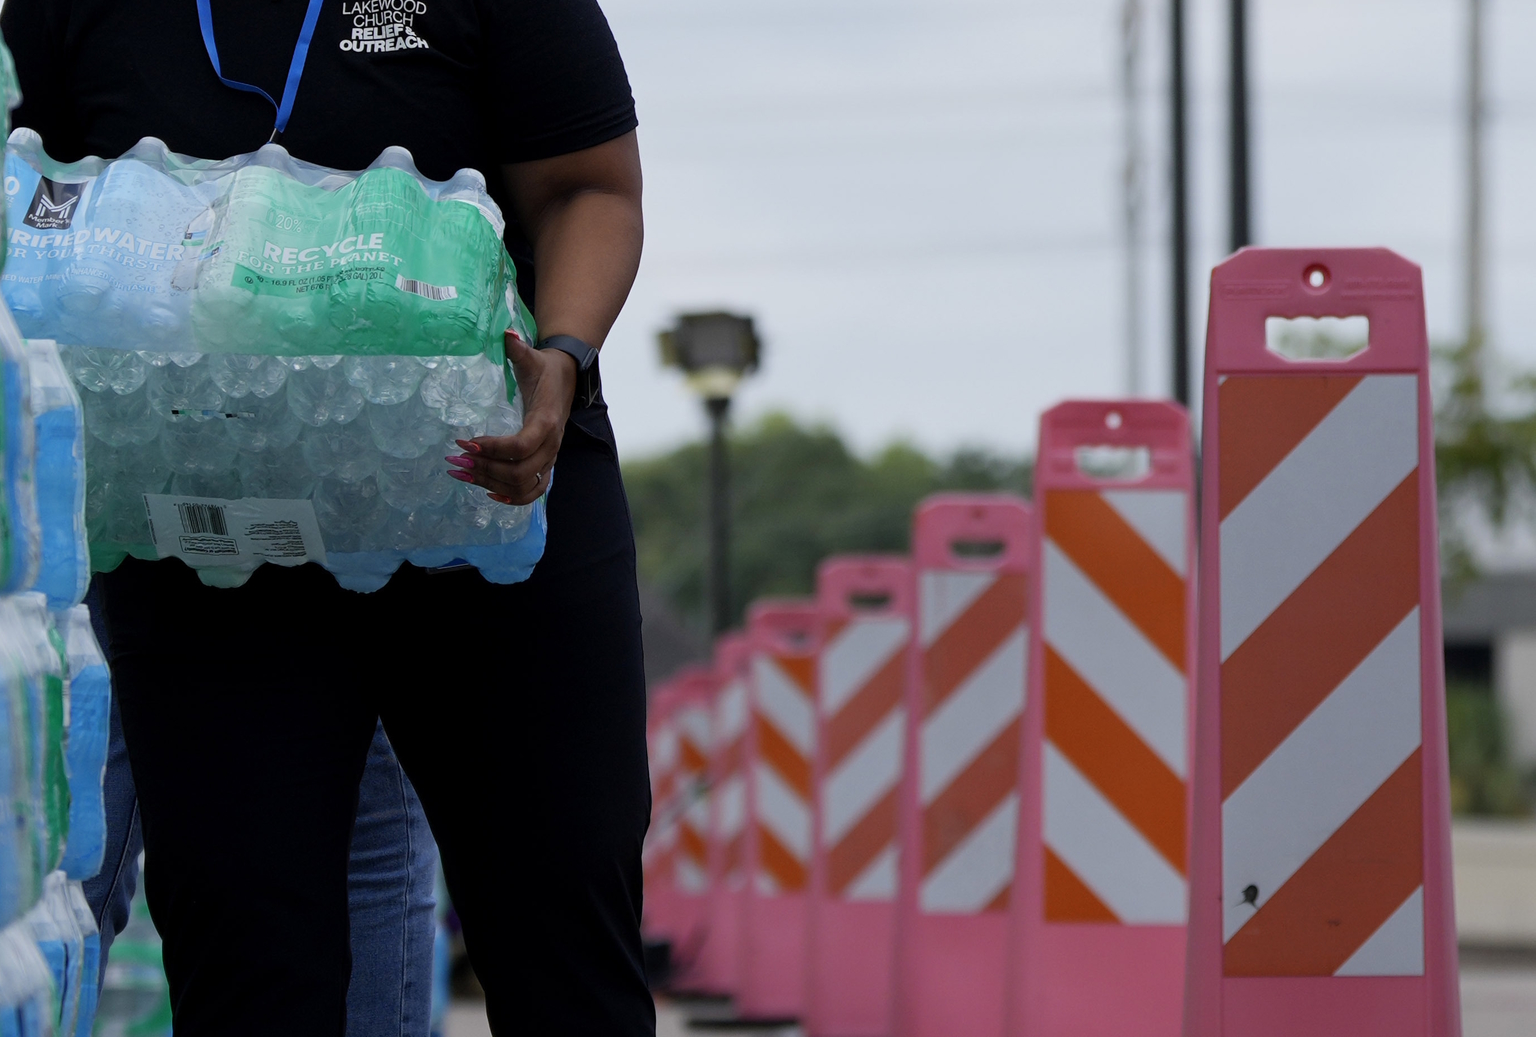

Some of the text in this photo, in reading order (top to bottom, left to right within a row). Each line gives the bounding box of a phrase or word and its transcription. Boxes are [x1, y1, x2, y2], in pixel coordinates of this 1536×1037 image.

[353, 10, 414, 27] CHURCH
[351, 24, 418, 40] RELIEF &
[339, 36, 430, 53] OUTREACH
[5, 176, 21, 195] 0
[28, 214, 70, 225] Member's
[275, 214, 302, 233] 20%
[7, 227, 184, 261] RIFIED WATER
[263, 232, 385, 265] RECYCLE
[87, 244, 162, 271] THIRST
[237, 250, 403, 275] FOR THE PLANET
[18, 275, 43, 284] WATER
[369, 271, 378, 280] 20
[296, 285, 309, 294] NET
